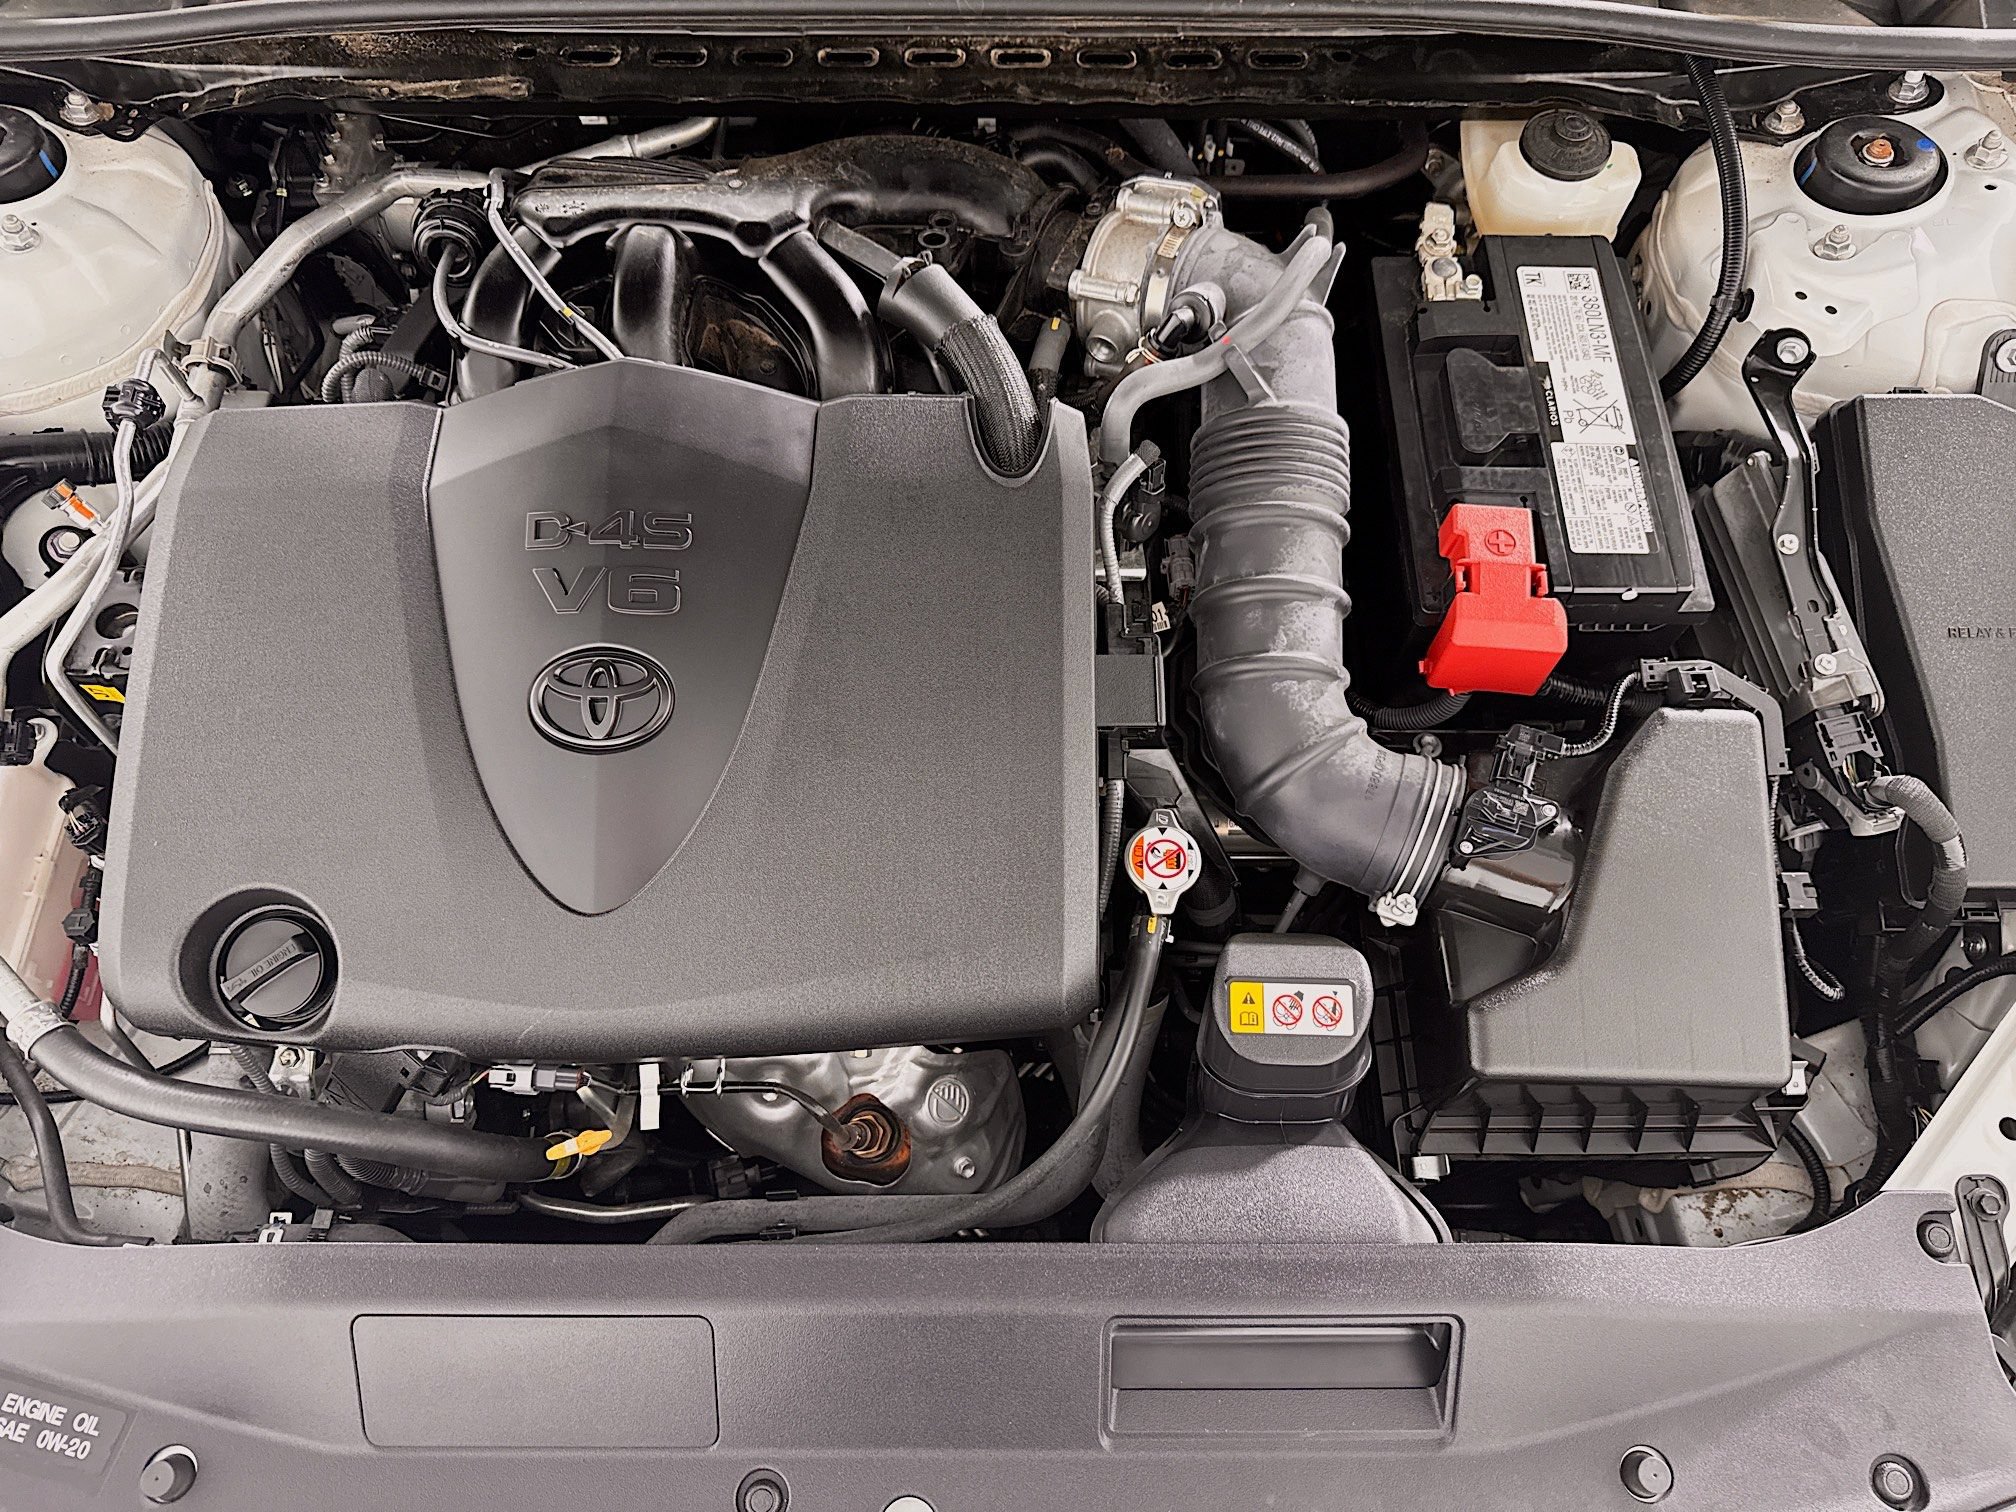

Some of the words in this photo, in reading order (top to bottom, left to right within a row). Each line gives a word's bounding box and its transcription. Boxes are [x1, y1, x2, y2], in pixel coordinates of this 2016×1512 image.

[1581, 295, 1613, 363] 380LN3-MF
[1545, 391, 1559, 426] CLARIOS
[1563, 410, 1574, 424] Pb
[533, 566, 681, 615] V6
[1947, 627, 1991, 638] RELAY
[250, 965, 264, 978] OIL
[265, 943, 297, 969] ENGINE
[0, 1392, 68, 1426] ENGINE
[72, 1412, 100, 1437] OIL
[36, 1429, 91, 1460] 0W-20
